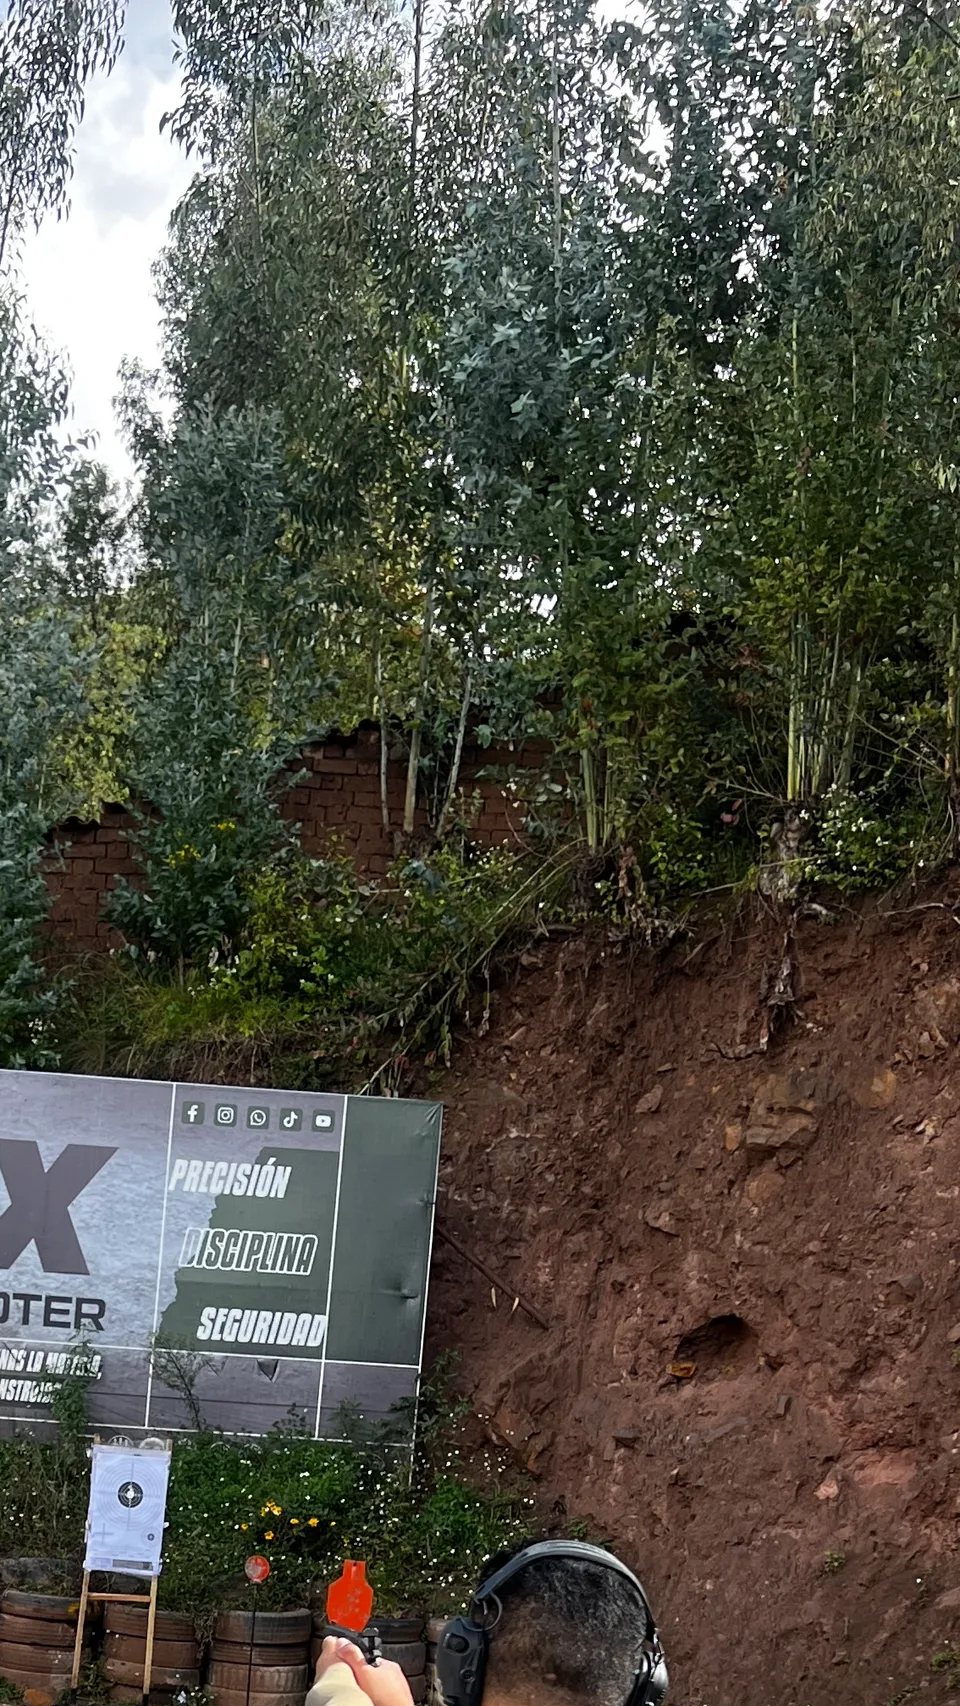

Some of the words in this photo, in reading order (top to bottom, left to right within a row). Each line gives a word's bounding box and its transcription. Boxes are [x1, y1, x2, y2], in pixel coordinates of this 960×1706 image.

[168, 1157, 292, 1198] PRECISIÓN
[178, 1227, 318, 1276] DISCIPLINA
[196, 1306, 327, 1347] SEGURIDAD
[26, 1350, 44, 1373] LA
